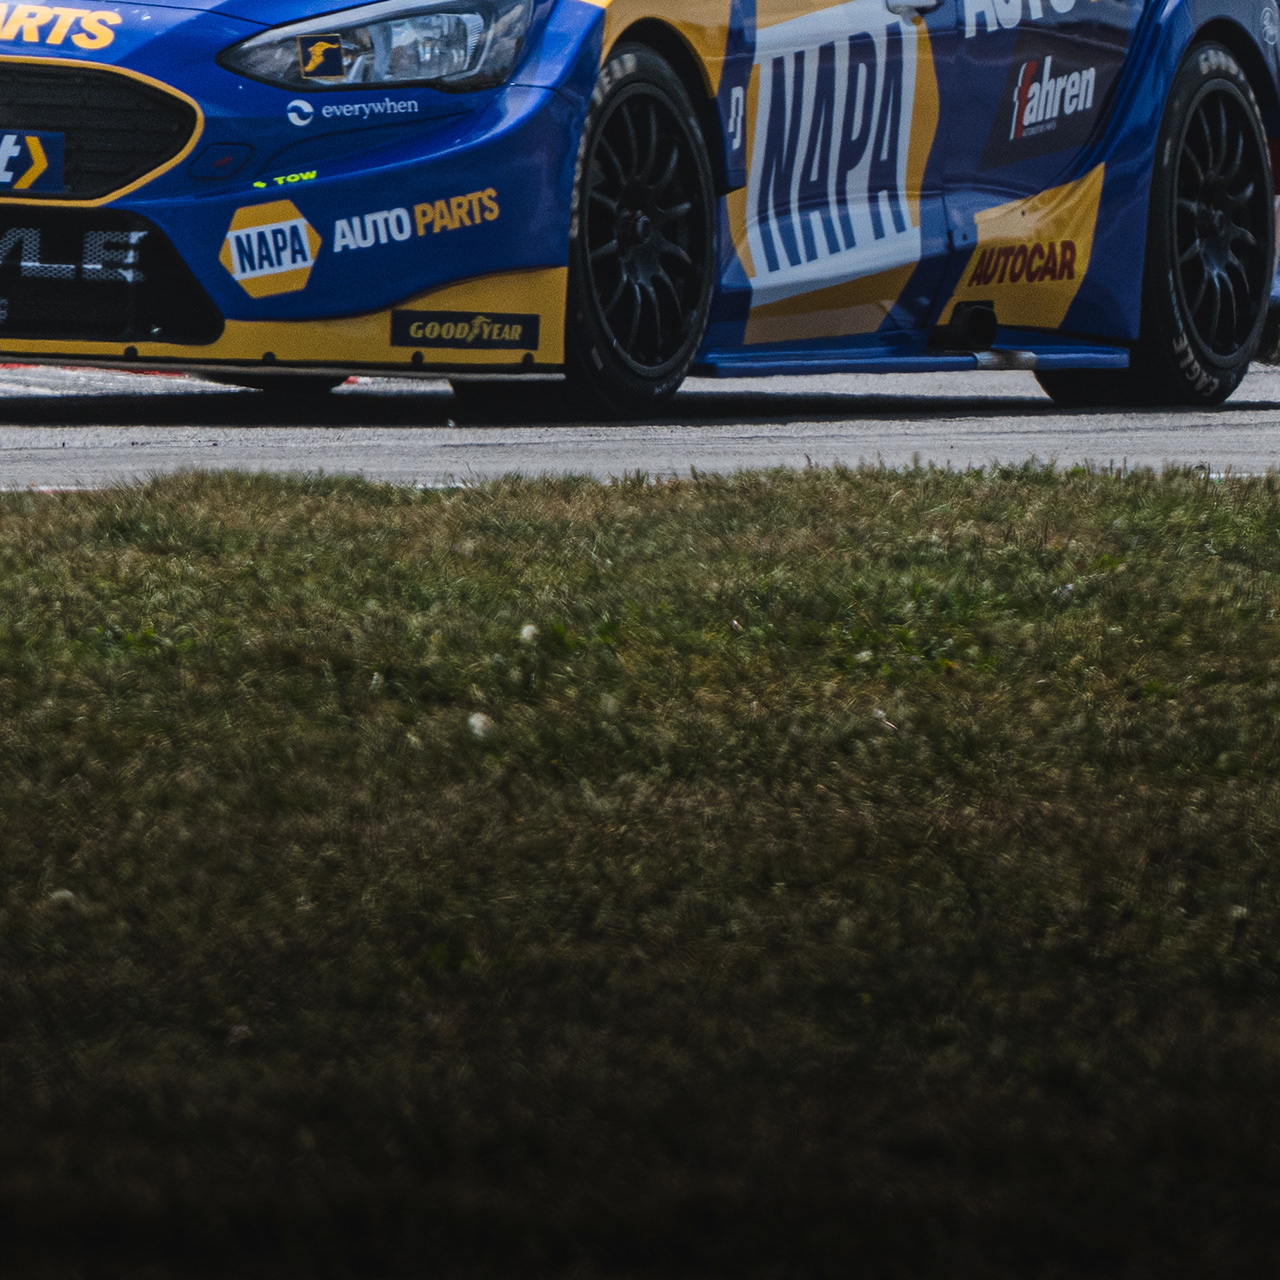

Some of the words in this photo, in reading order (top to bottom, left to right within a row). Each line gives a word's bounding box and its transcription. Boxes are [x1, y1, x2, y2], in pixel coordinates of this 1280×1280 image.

[322, 97, 420, 120] everywhen
[757, 21, 908, 275] NAPA
[274, 171, 317, 185] TOW
[333, 207, 412, 253] AUTO
[413, 188, 500, 237] PARTS
[234, 224, 309, 275] NAPA
[967, 239, 1077, 288] AUTOCAR
